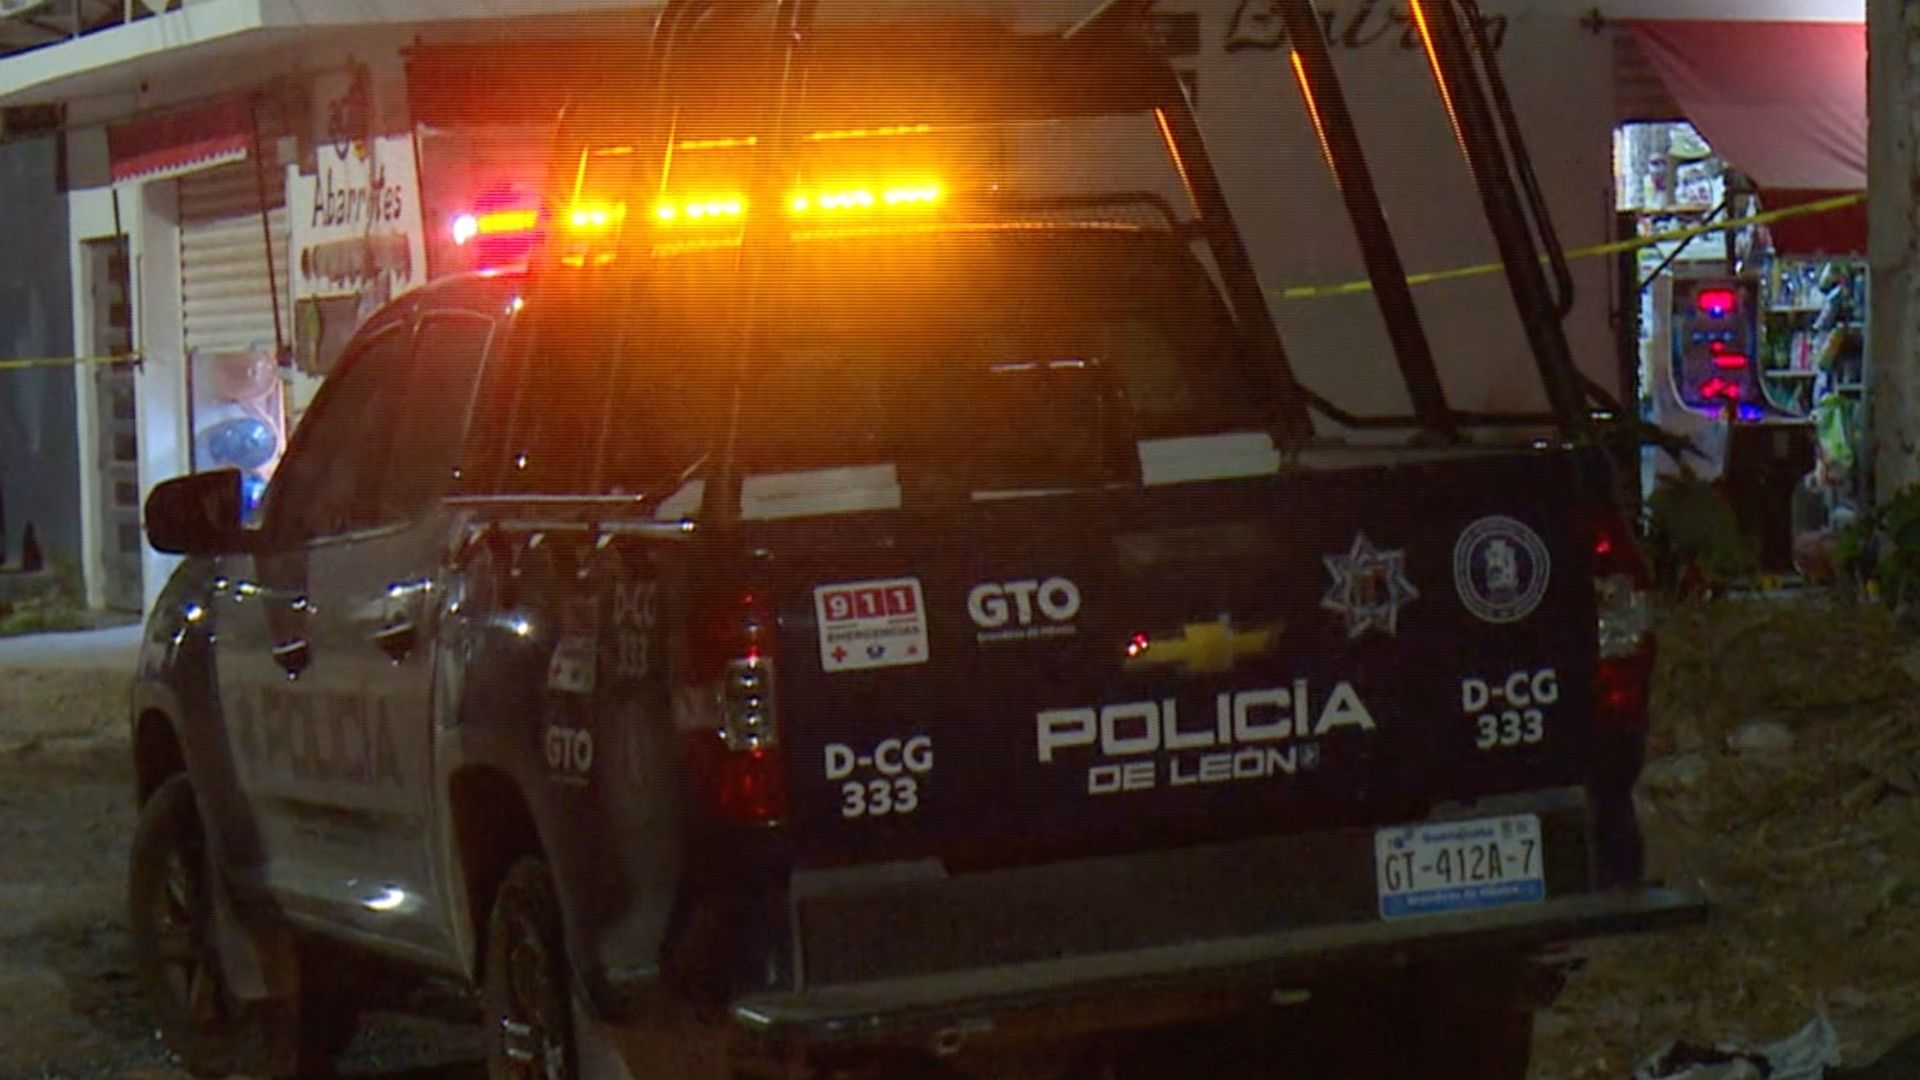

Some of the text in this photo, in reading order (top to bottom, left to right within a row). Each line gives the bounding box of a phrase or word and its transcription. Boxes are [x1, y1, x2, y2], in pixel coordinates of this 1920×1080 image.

[829, 590, 907, 619] 911
[967, 577, 1081, 628] GTO
[1461, 669, 1558, 713] D-CG
[1037, 678, 1376, 764] POLICÍA
[1475, 709, 1543, 750] 333
[546, 725, 594, 773] GTO
[824, 735, 933, 781] D-CG
[841, 776, 918, 818] 333
[1088, 761, 1156, 795] DE
[1385, 839, 1534, 891] GT-412A-7
